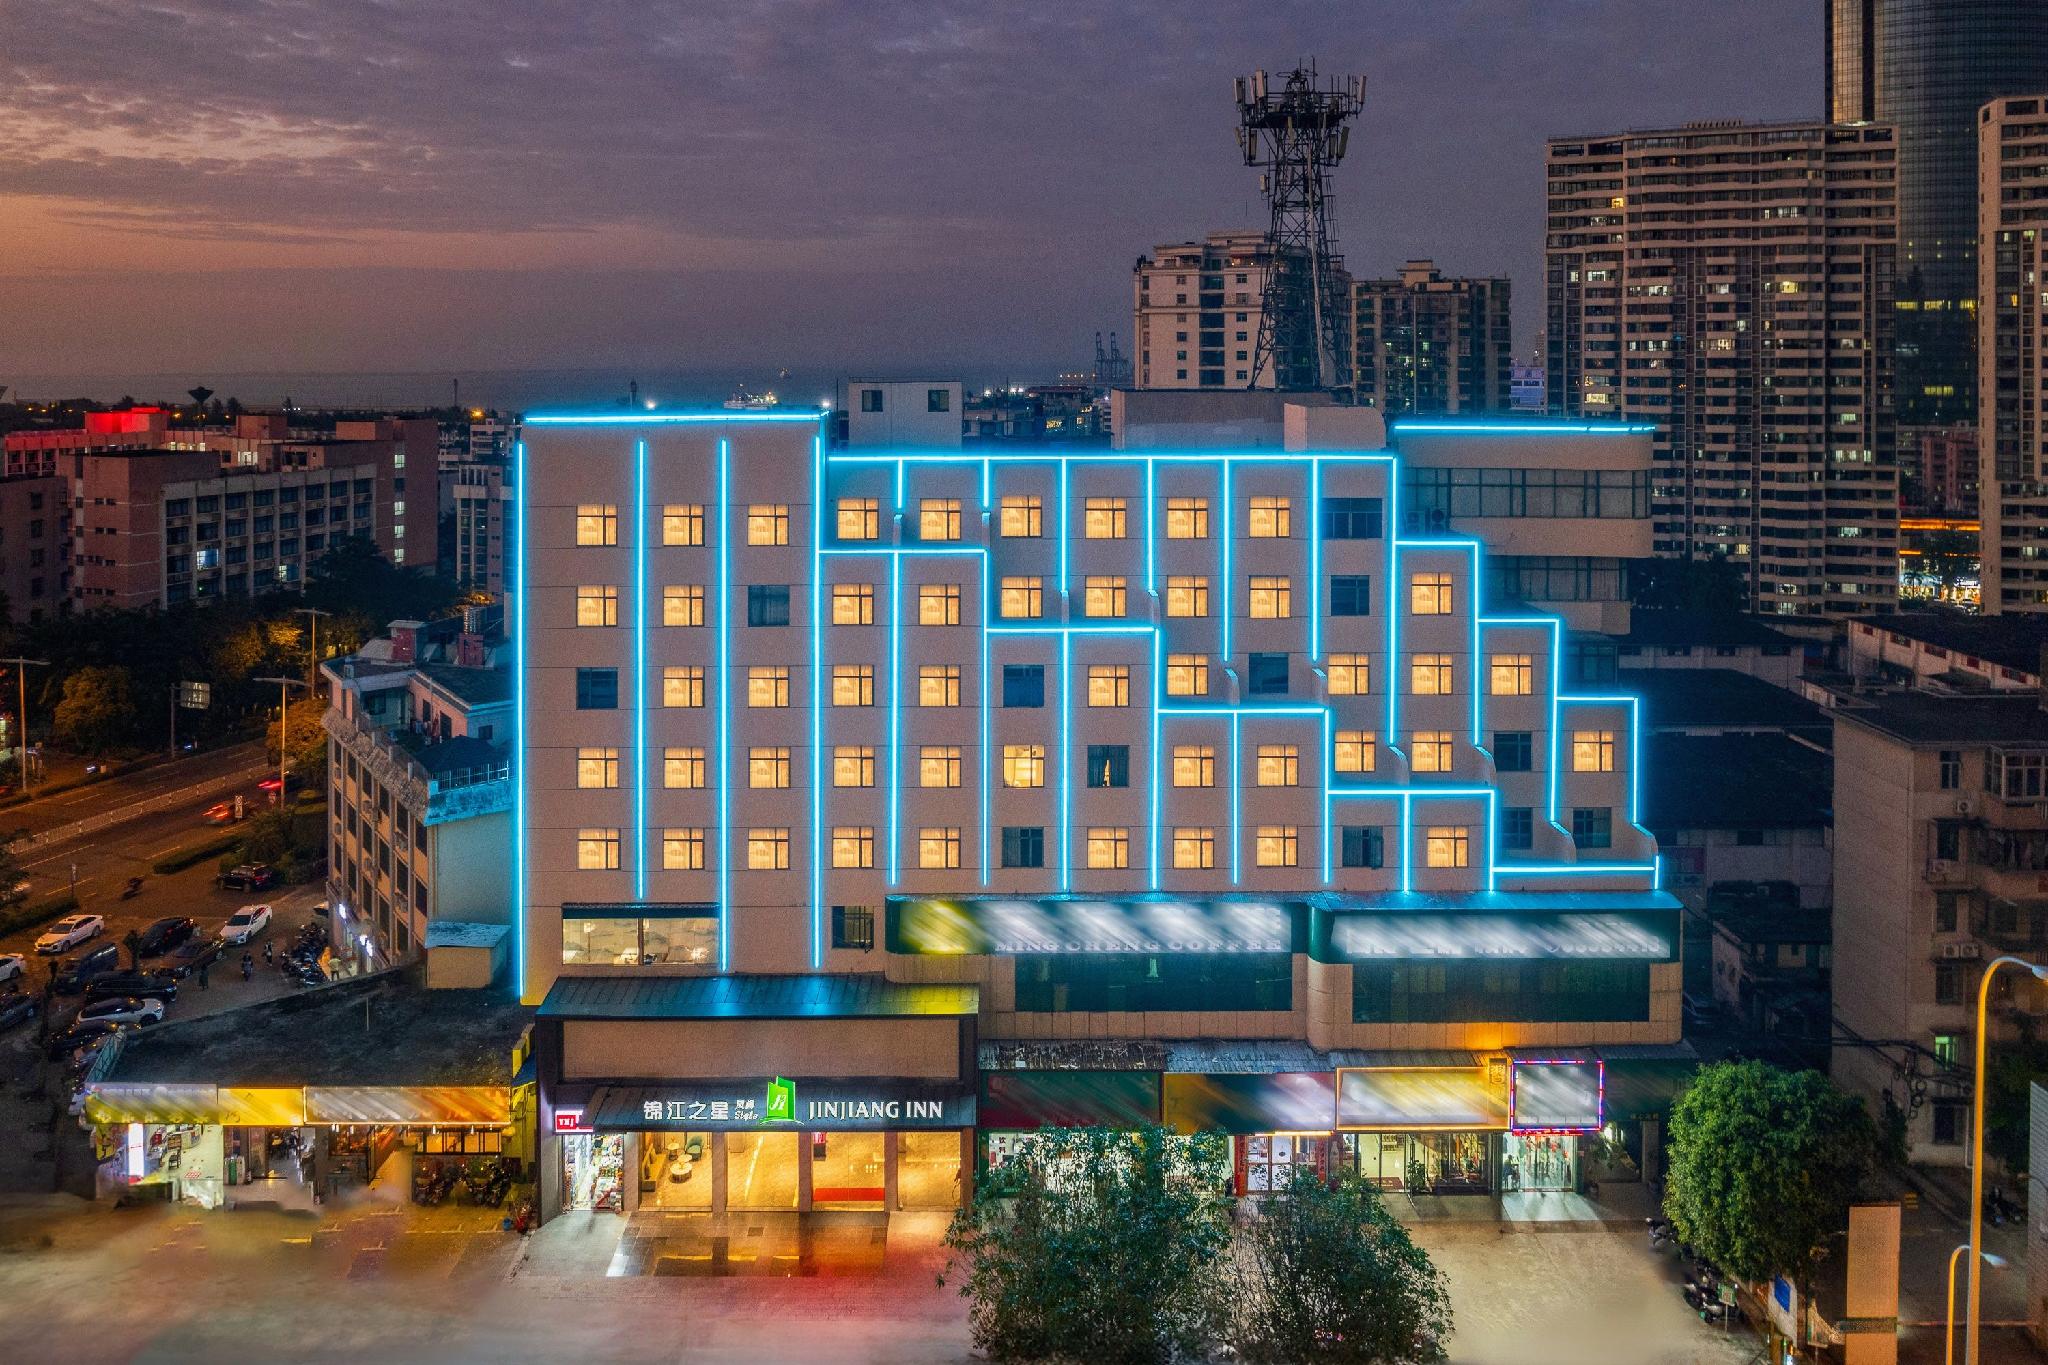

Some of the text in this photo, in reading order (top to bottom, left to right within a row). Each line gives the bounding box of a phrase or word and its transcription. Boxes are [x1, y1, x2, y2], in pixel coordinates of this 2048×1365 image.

[643, 1100, 729, 1120] 锦江之星
[809, 1101, 943, 1120] JINJIANG INN
